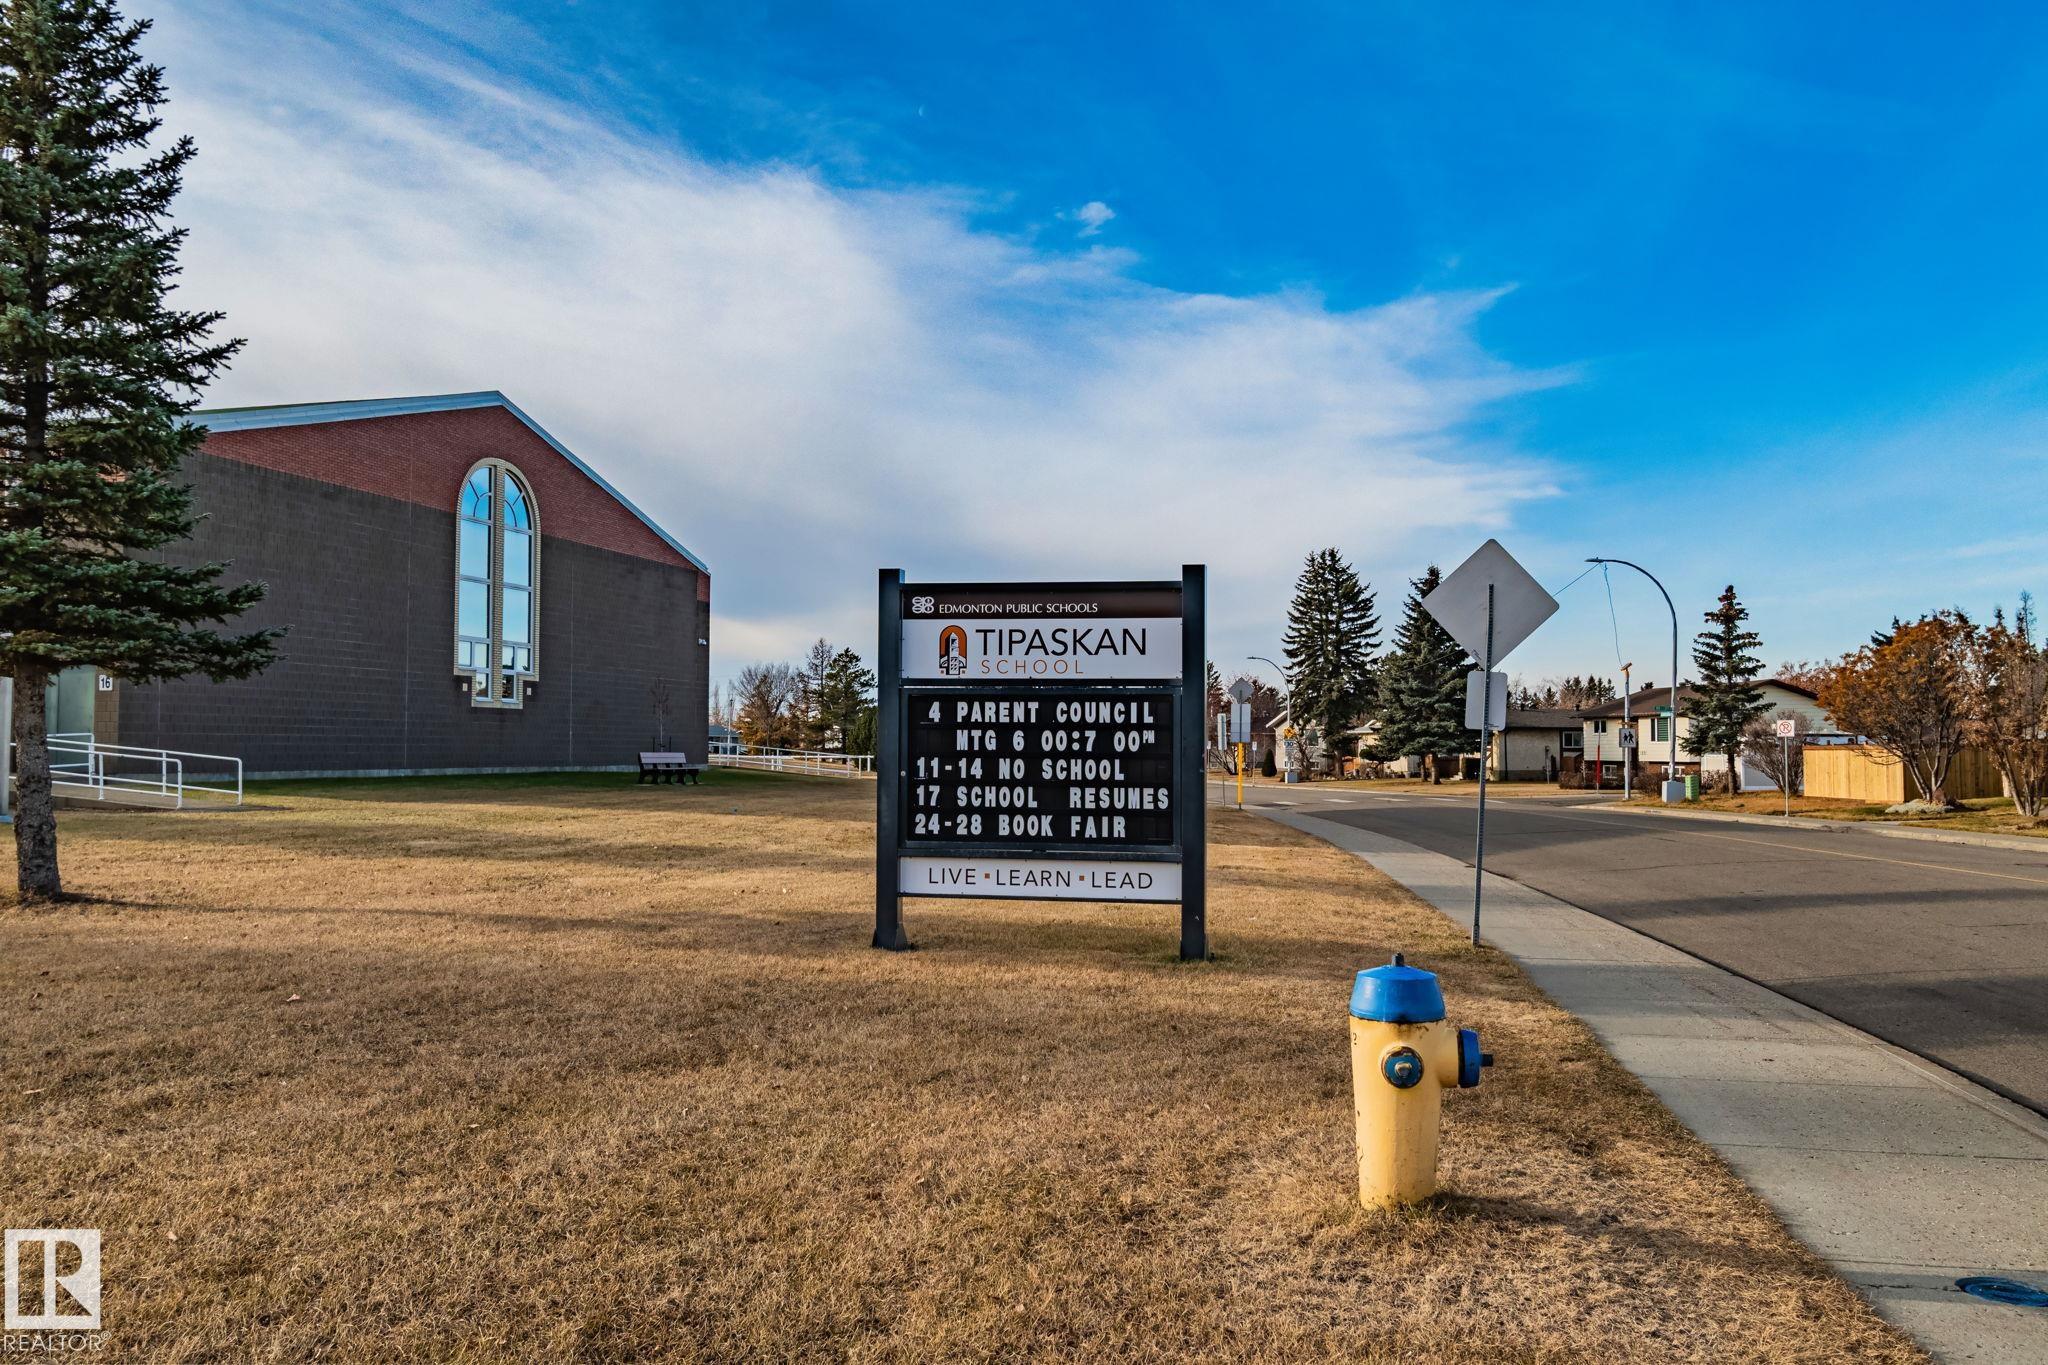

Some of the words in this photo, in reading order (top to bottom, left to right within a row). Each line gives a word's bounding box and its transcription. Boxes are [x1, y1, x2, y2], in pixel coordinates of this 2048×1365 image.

[939, 604, 1002, 613] EDMONTON
[1006, 604, 1043, 613] PUBLIC
[1046, 603, 1098, 613] SCHOOLS
[975, 628, 1146, 656] TIPASKAN
[981, 659, 1084, 674] SCHOOL
[100, 676, 111, 688] 16
[928, 702, 941, 723] 4
[957, 702, 1039, 723] PARENT
[1056, 702, 1153, 723] COUNCIL
[956, 730, 997, 751] MTG
[1013, 730, 1024, 751] 6
[917, 757, 983, 779] 11-14
[999, 758, 1025, 780] NO
[1042, 758, 1124, 781] SCHOOL
[917, 785, 941, 806] 17
[957, 786, 1038, 808] SCHOOL
[1069, 786, 1169, 809] RESUMES
[915, 814, 983, 835] 24-28
[999, 814, 1053, 837] BOOK
[1071, 815, 1126, 838] FAIR
[929, 868, 977, 885] LIVE
[996, 869, 1071, 887] LEARN
[1092, 871, 1153, 889] LEAD
